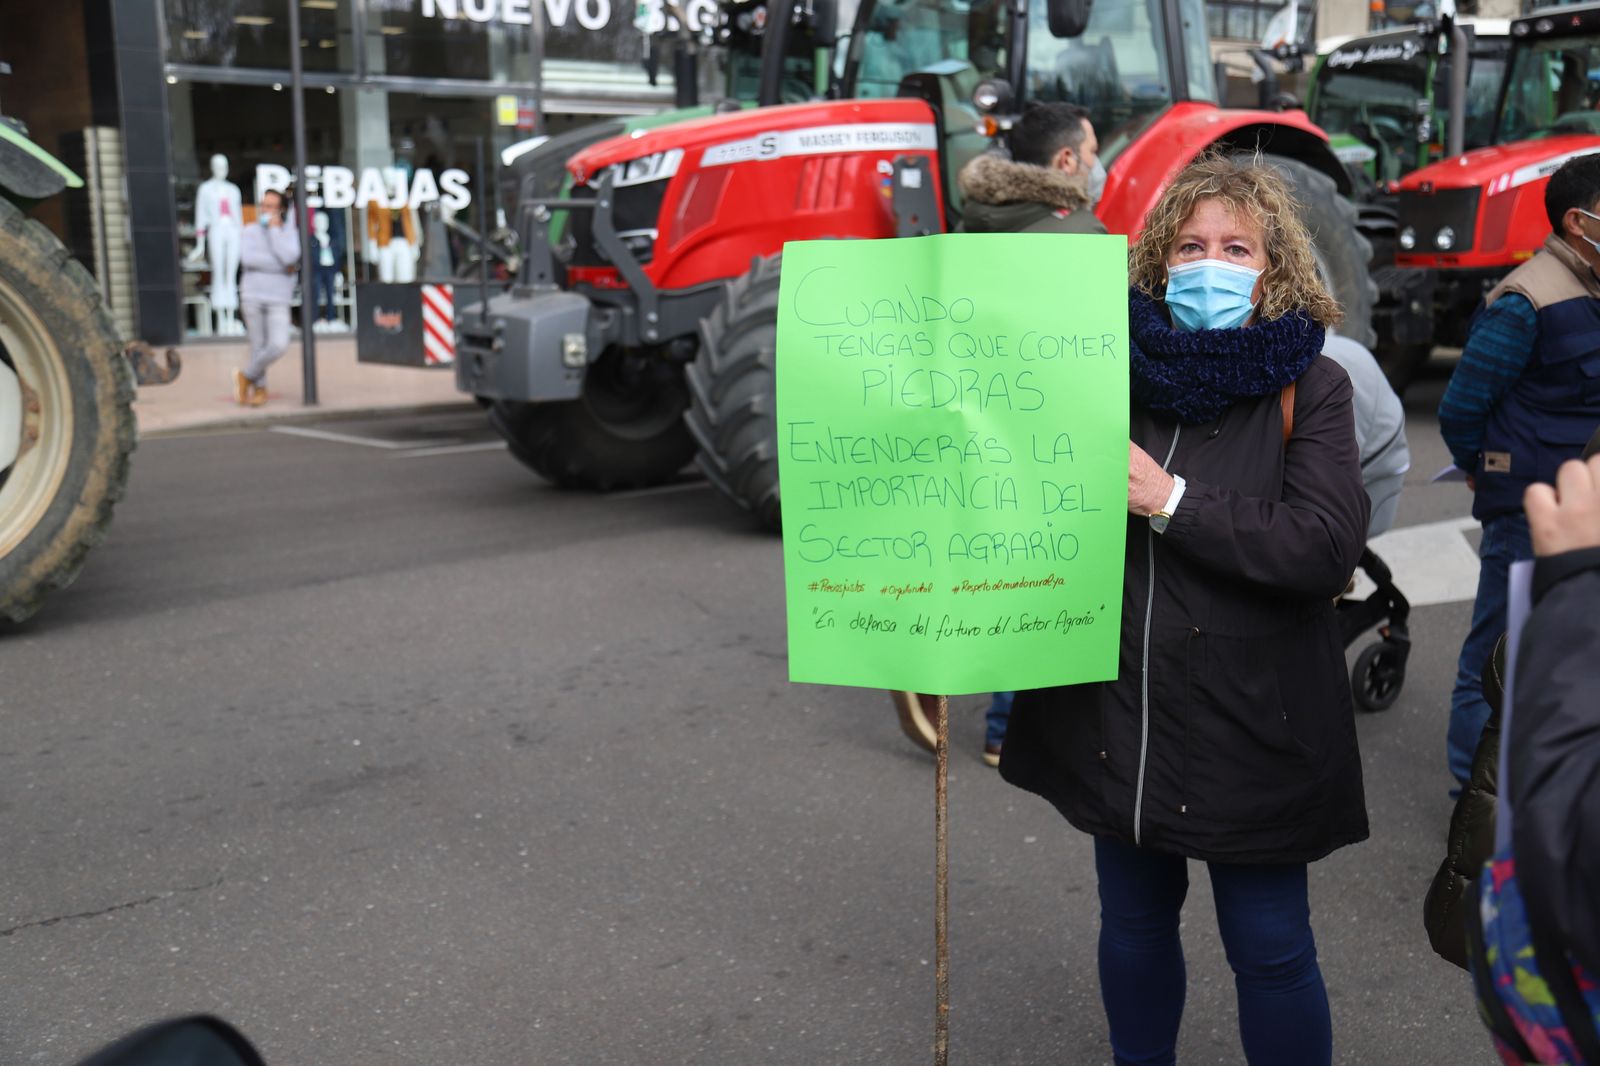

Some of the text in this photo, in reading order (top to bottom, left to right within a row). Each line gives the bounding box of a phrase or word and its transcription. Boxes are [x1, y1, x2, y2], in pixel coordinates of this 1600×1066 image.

[422, 0, 612, 30] NUEVO
[799, 132, 852, 148] MASSEY
[856, 131, 923, 144] FERGUSON
[256, 163, 472, 211] REBAJAS
[794, 266, 975, 328] CUANDO
[813, 330, 1117, 362] TENGAS QUE COMER
[1032, 432, 1074, 465] LA
[1041, 480, 1102, 515] DEL
[799, 523, 932, 568] SECTOR
[849, 611, 898, 635] defensa
[909, 613, 931, 637] del
[935, 614, 982, 642] futuro
[987, 615, 1012, 637] del
[1012, 612, 1053, 634] Sector
